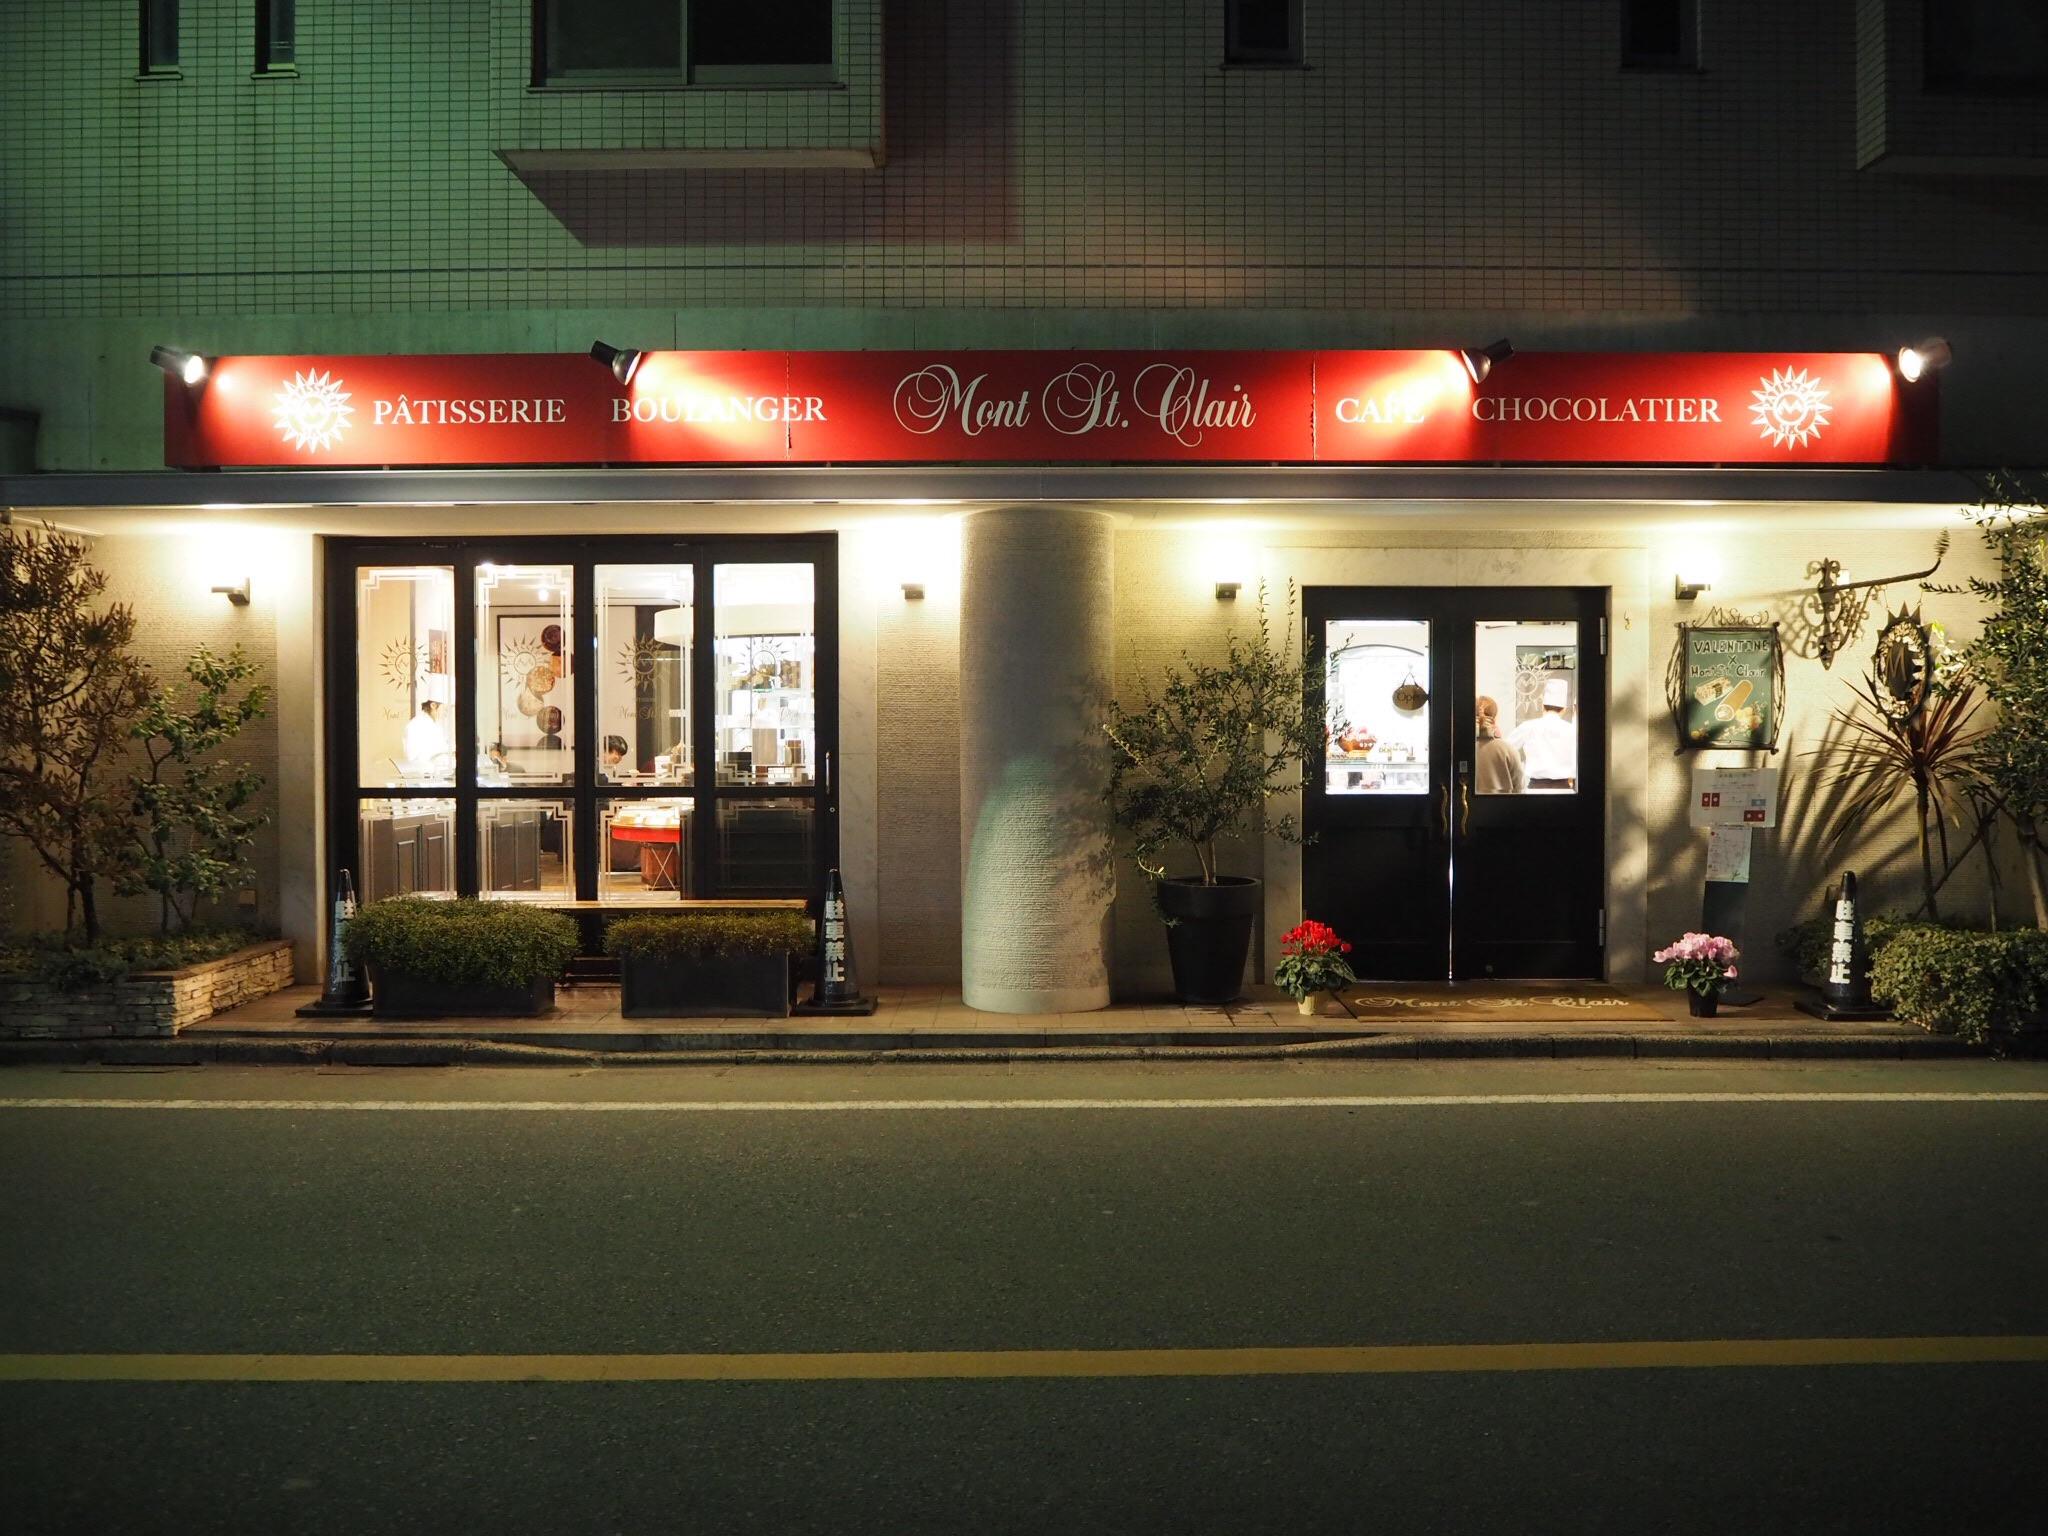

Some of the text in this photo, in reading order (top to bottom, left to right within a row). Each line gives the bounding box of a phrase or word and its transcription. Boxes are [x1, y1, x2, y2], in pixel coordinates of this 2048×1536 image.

[373, 394, 567, 425] PÂTISSERIE
[894, 363, 1257, 447] Mont St. Clair
[1472, 397, 1723, 423] CHOCOLATIER
[1693, 639, 1770, 654] VALENTINE
[825, 899, 845, 982] 駐車禁止
[1829, 899, 1855, 984] 駐車禁止
